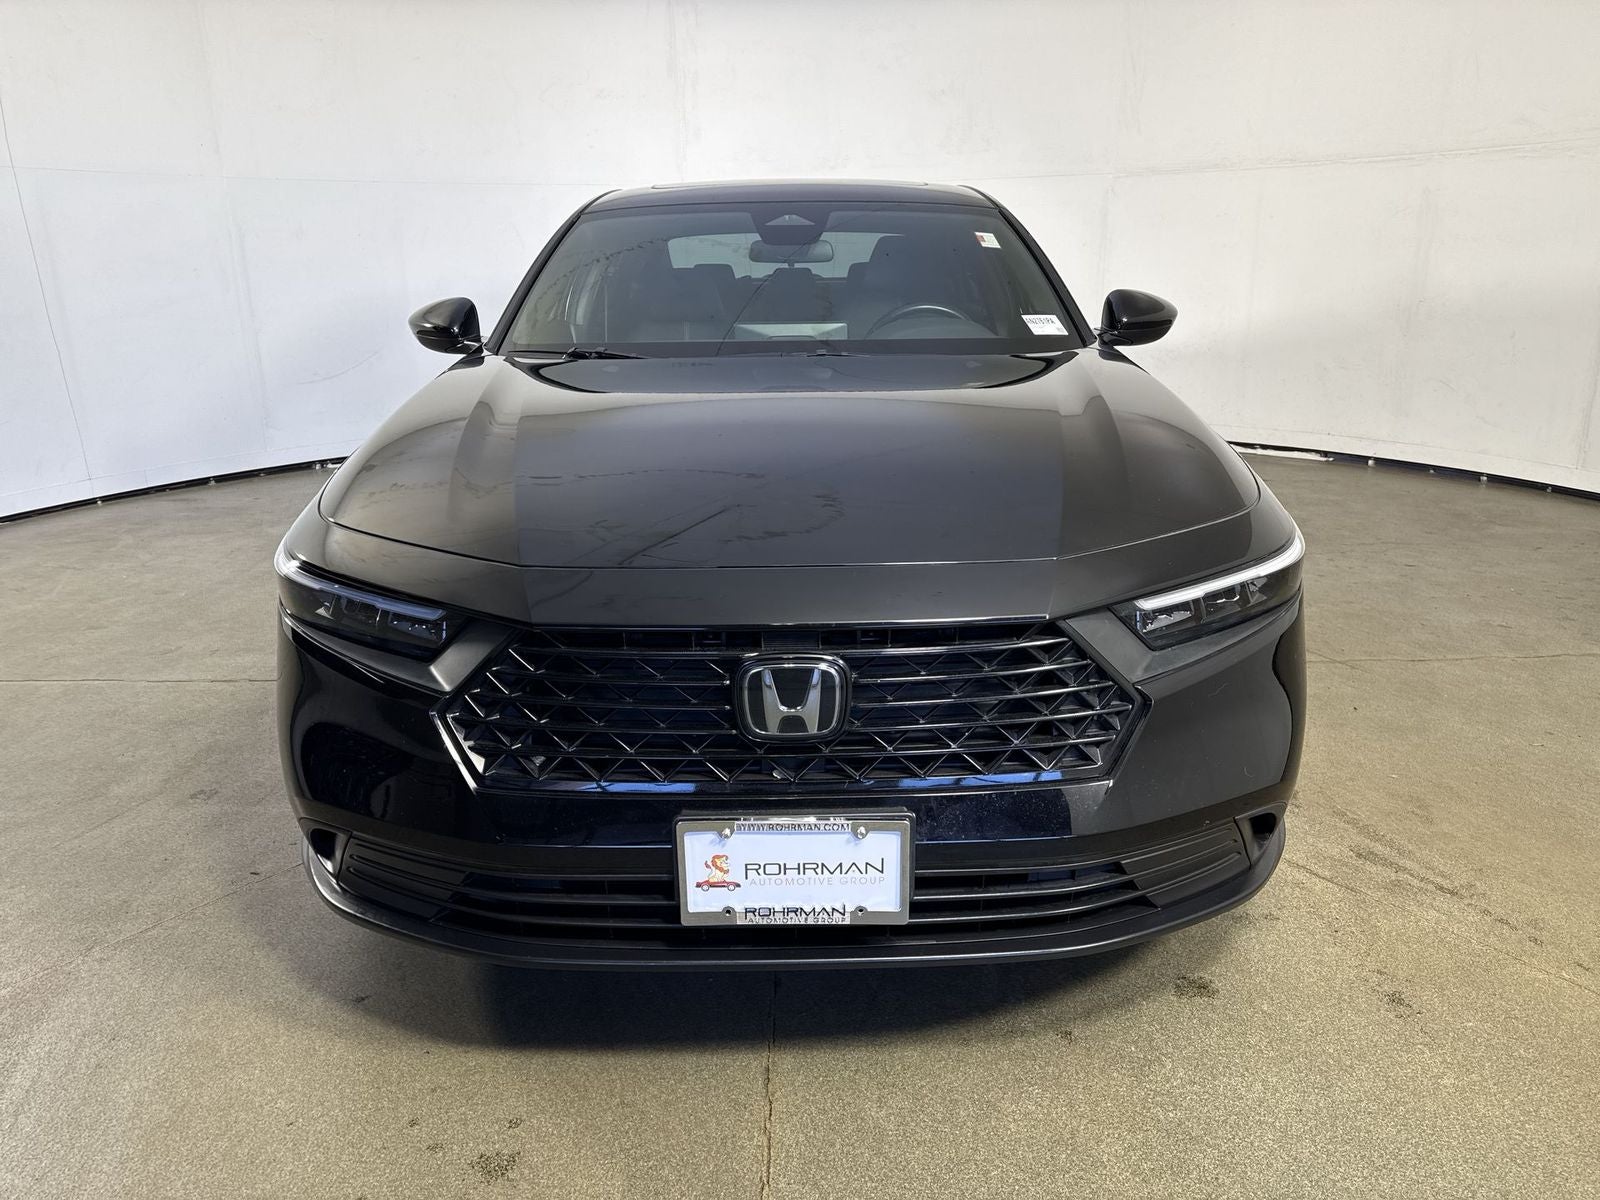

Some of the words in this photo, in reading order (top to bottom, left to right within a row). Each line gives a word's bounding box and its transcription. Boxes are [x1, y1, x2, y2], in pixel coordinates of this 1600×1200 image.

[736, 822, 850, 832] WWW.ROHRMAN.COM
[744, 857, 885, 880] ROHRMAN
[750, 877, 833, 886] AUTOMOTIVE
[839, 876, 886, 885] GROUP
[744, 903, 846, 919] ROHRMAN
